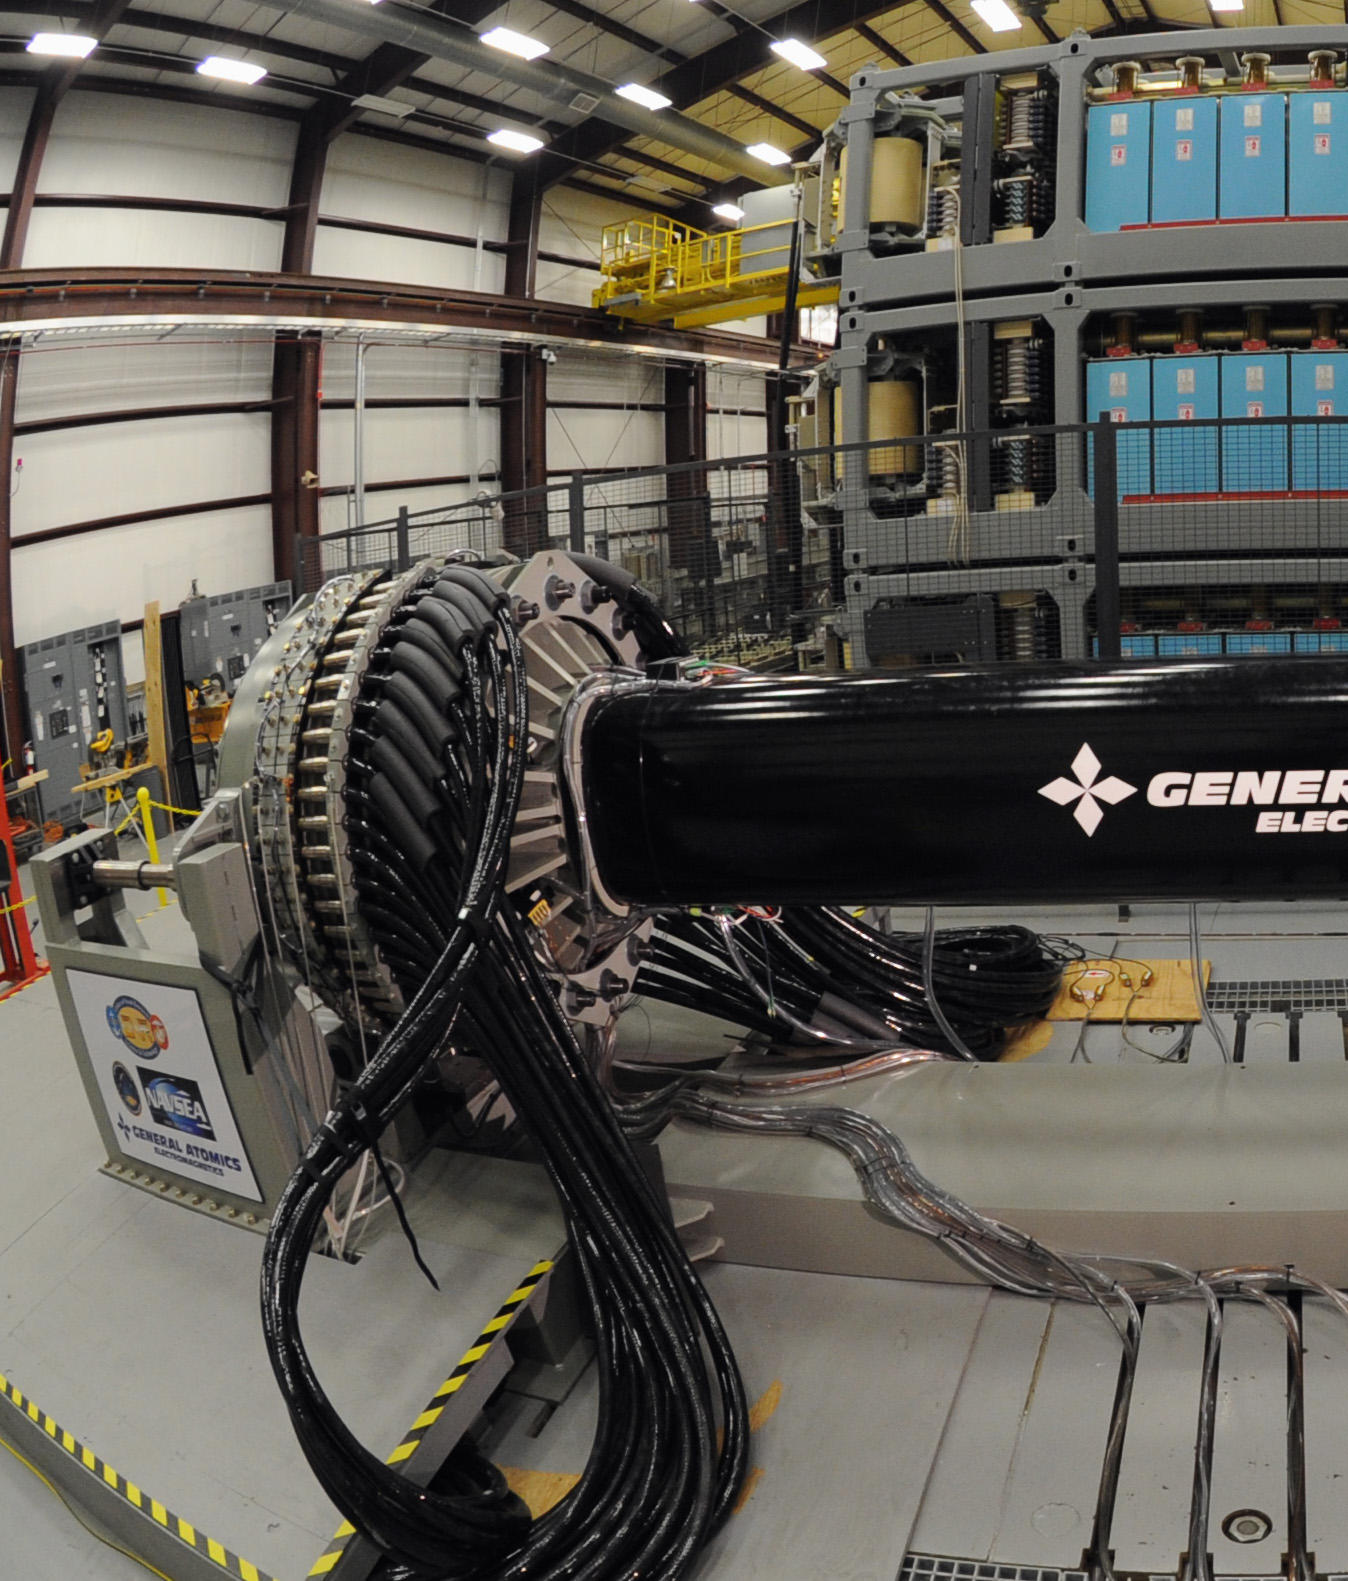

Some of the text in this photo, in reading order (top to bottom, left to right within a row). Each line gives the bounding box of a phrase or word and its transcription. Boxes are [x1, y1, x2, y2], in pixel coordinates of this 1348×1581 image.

[145, 1087, 210, 1127] NAVSEA
[132, 1125, 183, 1153] GENERAL
[186, 1143, 242, 1172] ATOMICS
